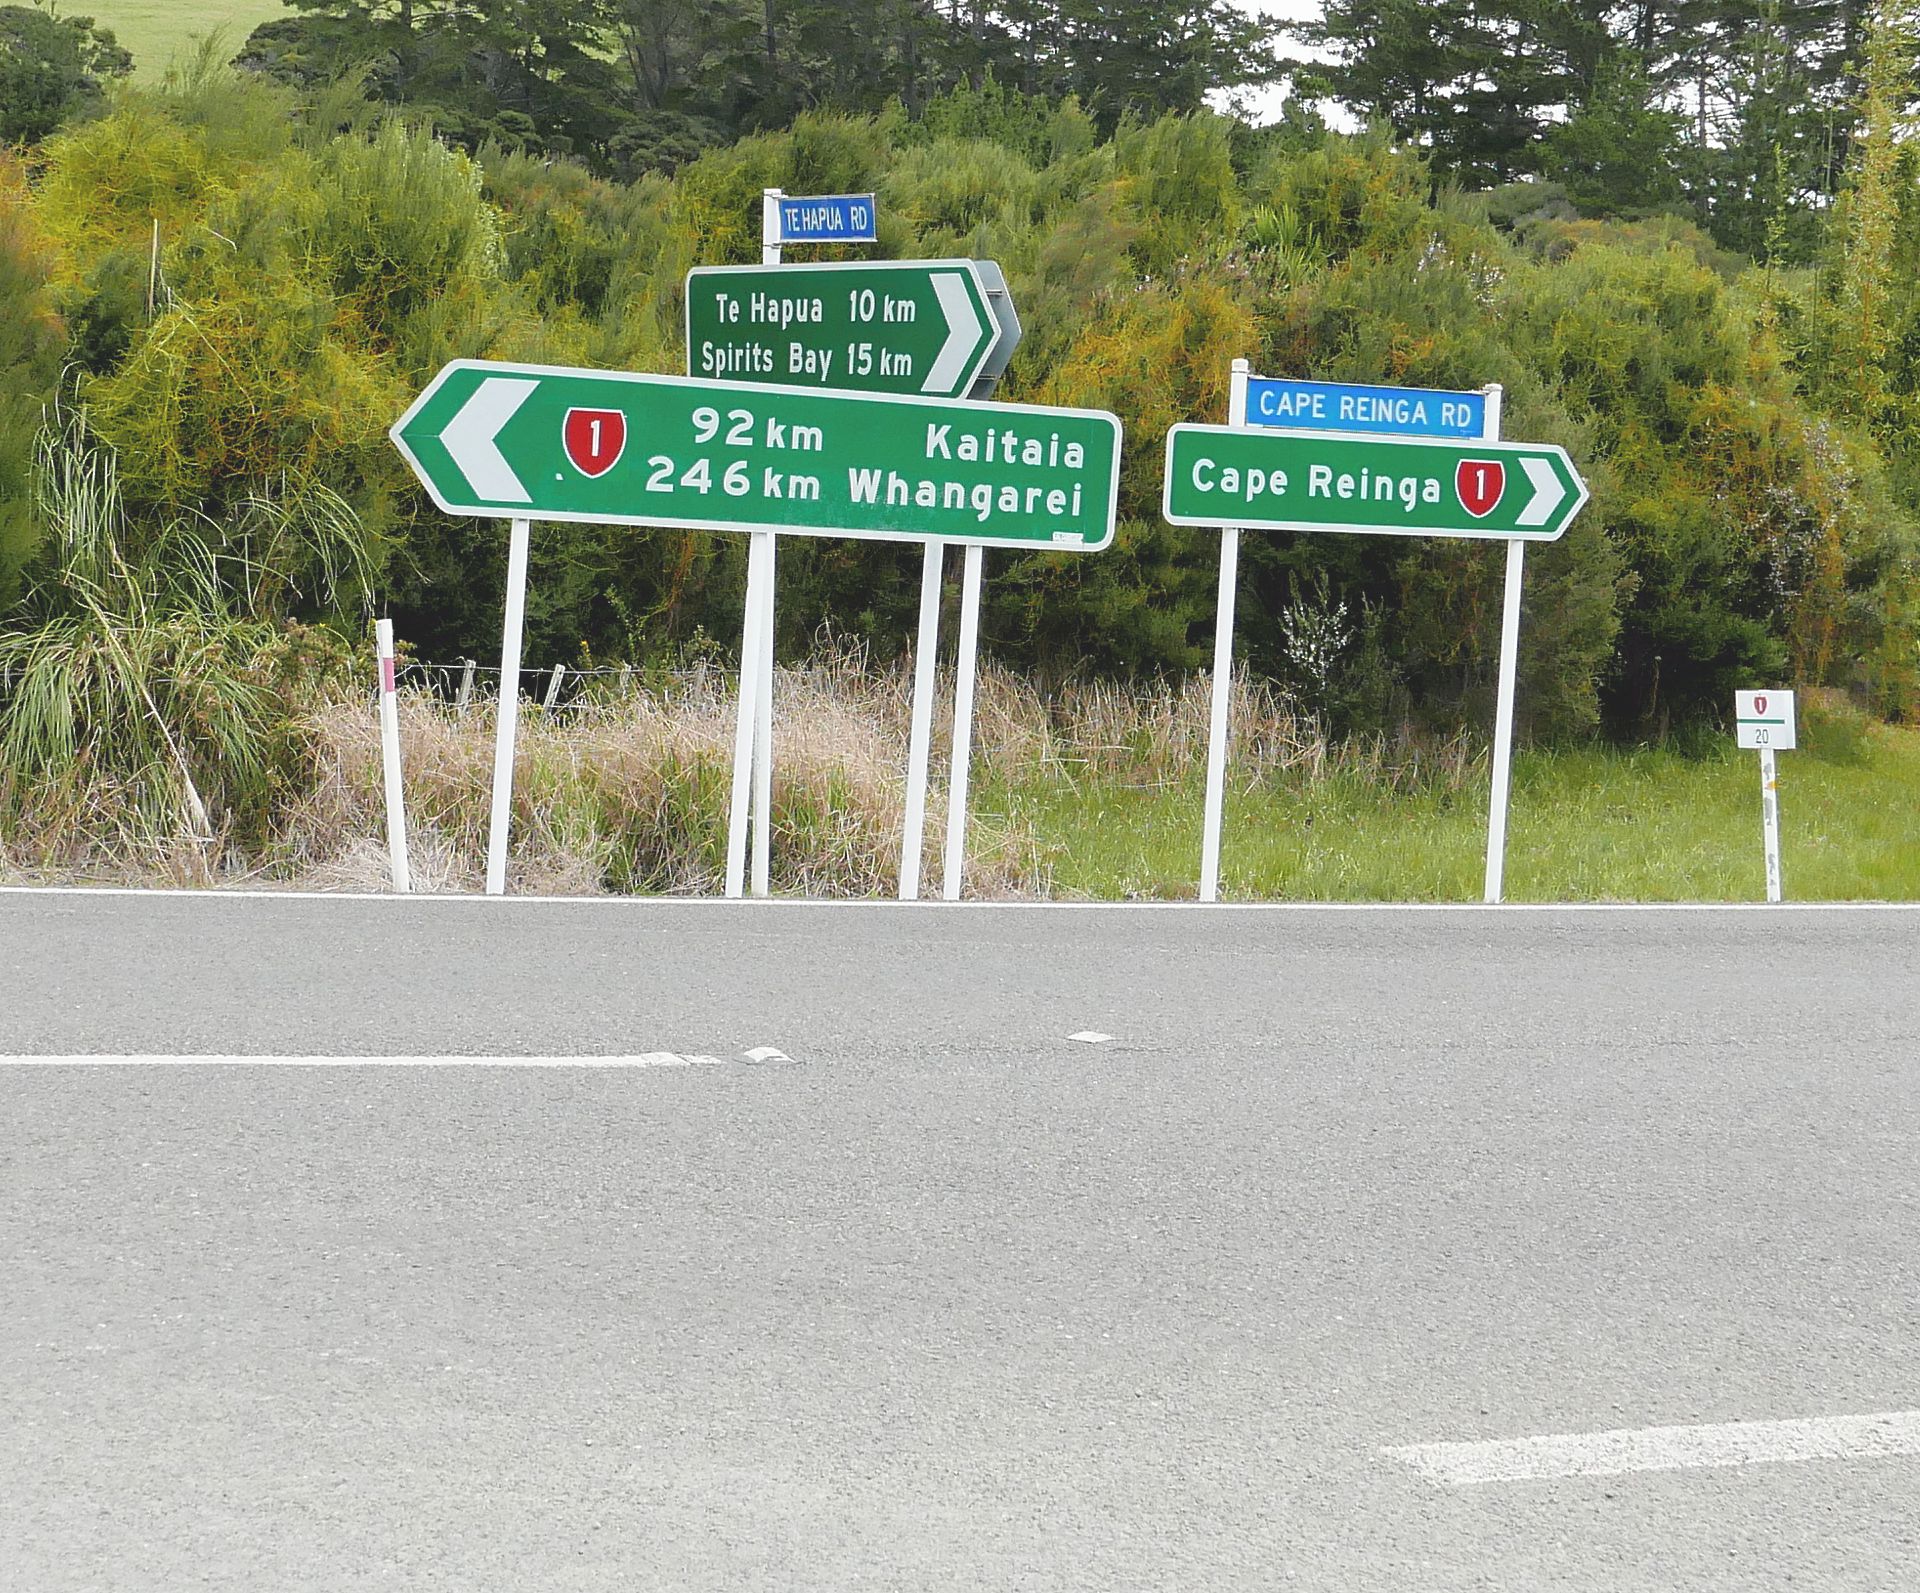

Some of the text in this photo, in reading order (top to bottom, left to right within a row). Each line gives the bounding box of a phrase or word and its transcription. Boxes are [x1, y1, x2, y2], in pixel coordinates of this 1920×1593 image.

[785, 206, 867, 232] TE HAPUA RD
[716, 289, 916, 330] Te Hapua 10 km
[702, 342, 912, 382] Spirits Bay 15 km
[1260, 391, 1472, 428] CAPE REINGA RD
[590, 419, 601, 457] 1
[692, 406, 1084, 469] 92 km Kaitaia
[645, 455, 1082, 522] 246 km Whangarei
[1192, 458, 1485, 513] Cape Reinga 1
[1755, 729, 1769, 744] 20
